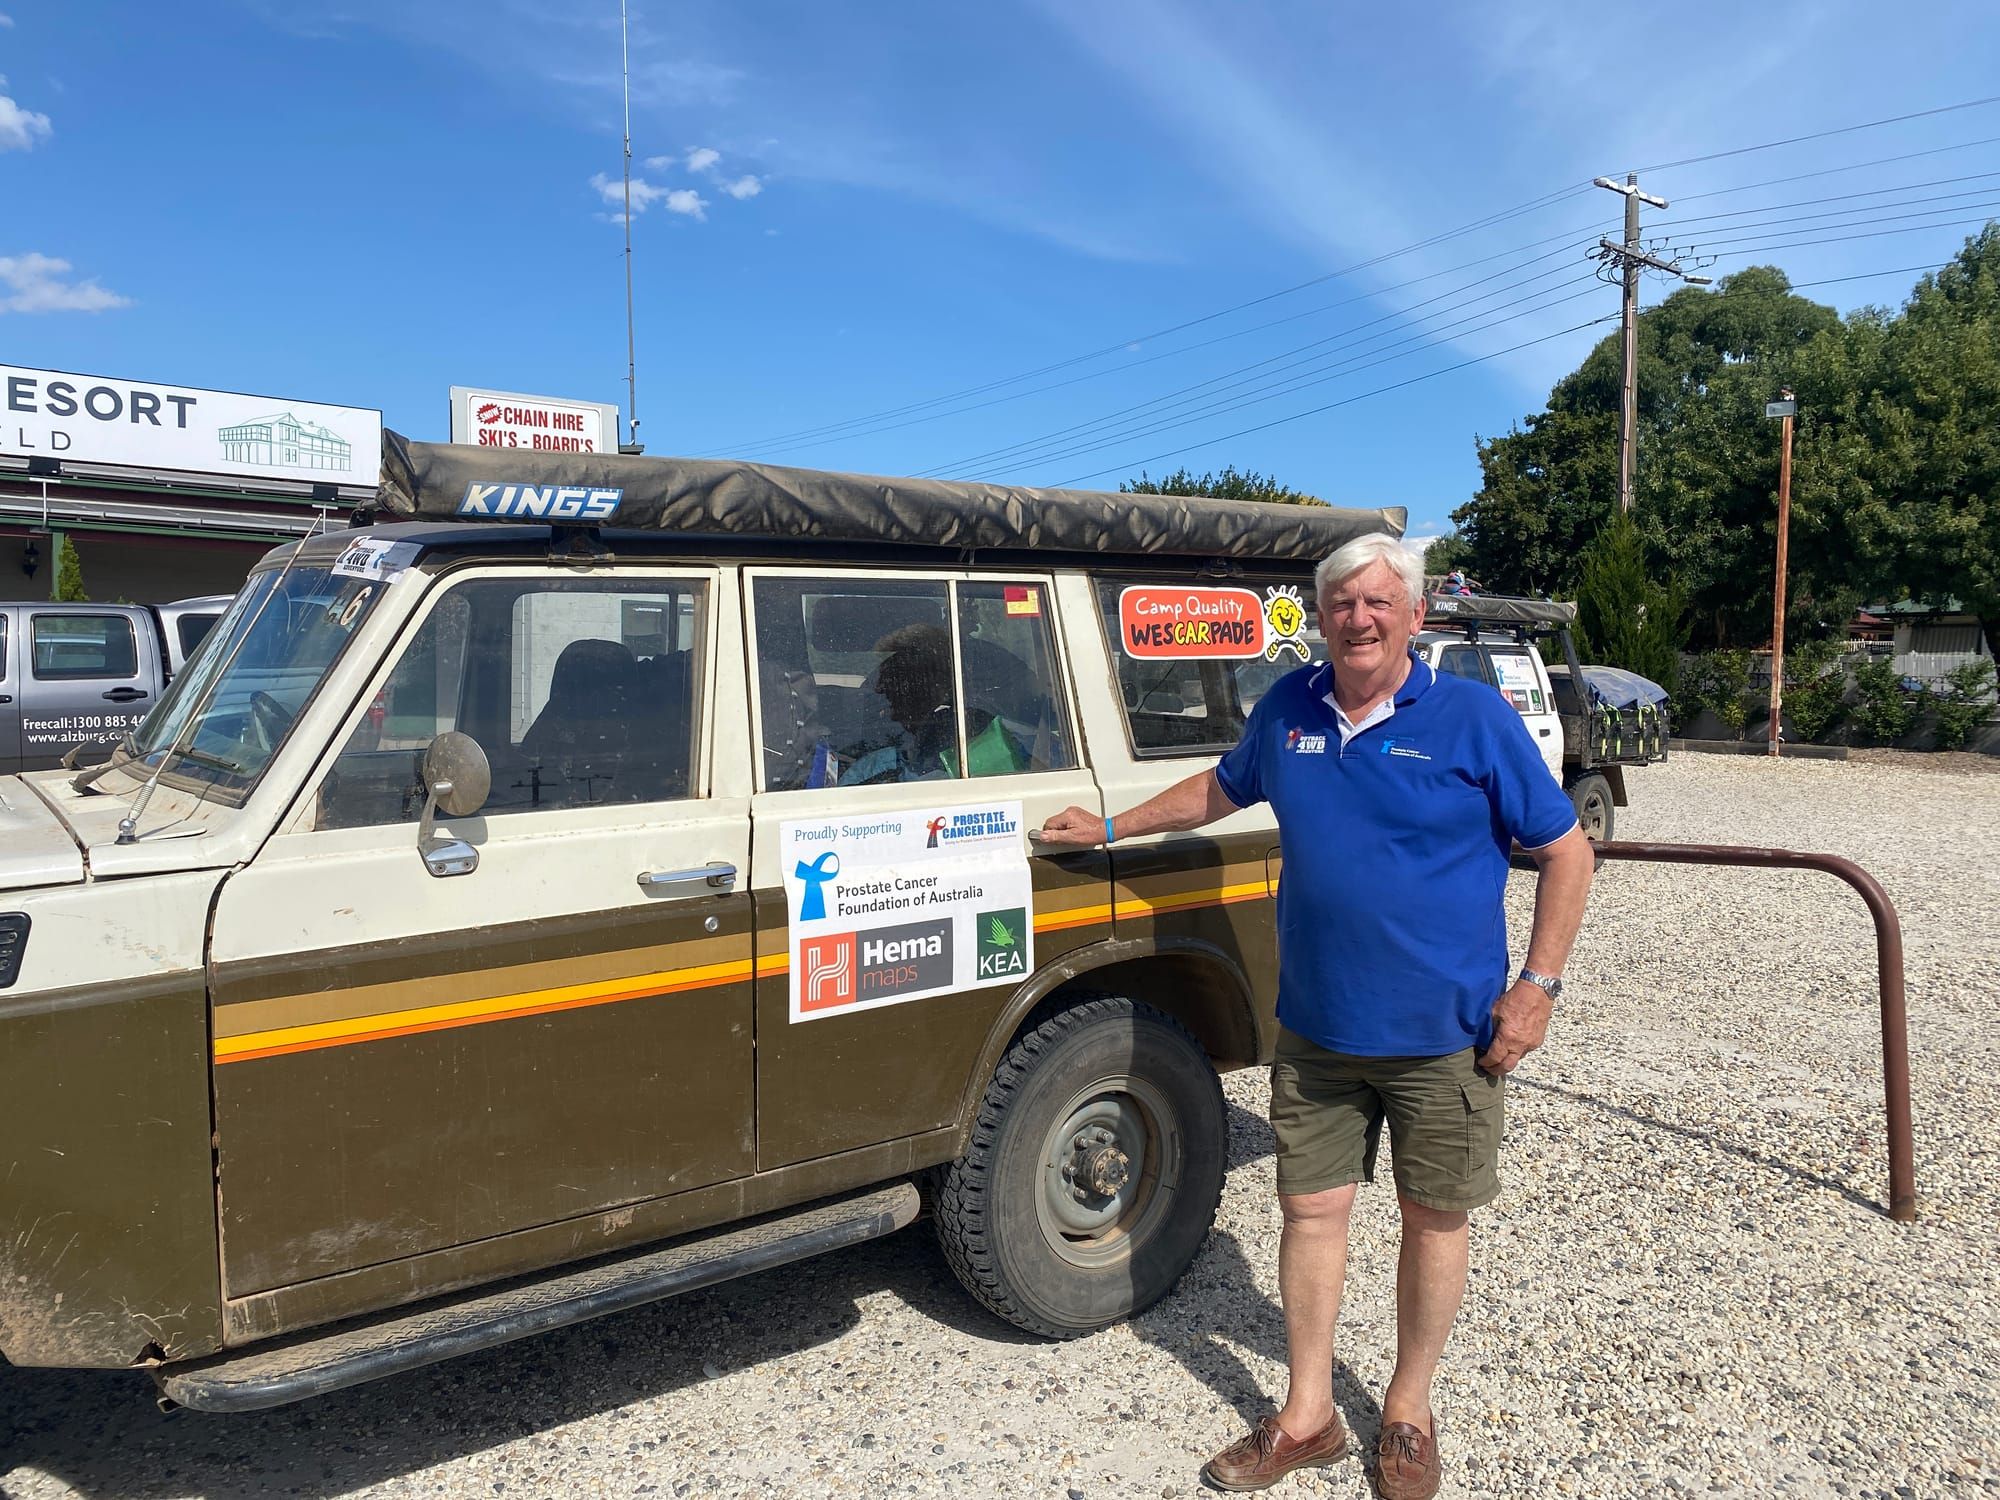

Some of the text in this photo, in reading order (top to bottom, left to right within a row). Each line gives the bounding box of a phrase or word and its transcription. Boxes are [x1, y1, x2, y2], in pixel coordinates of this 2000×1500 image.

[8, 376, 197, 428] ESORT
[504, 407, 548, 428] CHAIN
[553, 412, 584, 432] HIRE
[0, 426, 71, 450] LD
[479, 429, 517, 448] SKI'S
[533, 434, 593, 452] BOARD'S
[461, 485, 620, 518] KINGS
[1136, 596, 1243, 620] Camp Quality
[1131, 620, 1254, 647] WESCARPADE
[105, 715, 127, 728] 885
[1297, 740, 1326, 750] 4WD
[942, 821, 1016, 839] CANCER RALLY
[953, 811, 1005, 826] PROSTATE
[795, 821, 901, 842] Proudly Supporting
[836, 876, 938, 898] Prostate Cancer
[838, 885, 983, 916] Foundation of Australia
[863, 935, 942, 967] Hema
[980, 951, 1024, 976] KEA
[863, 965, 918, 989] maps
